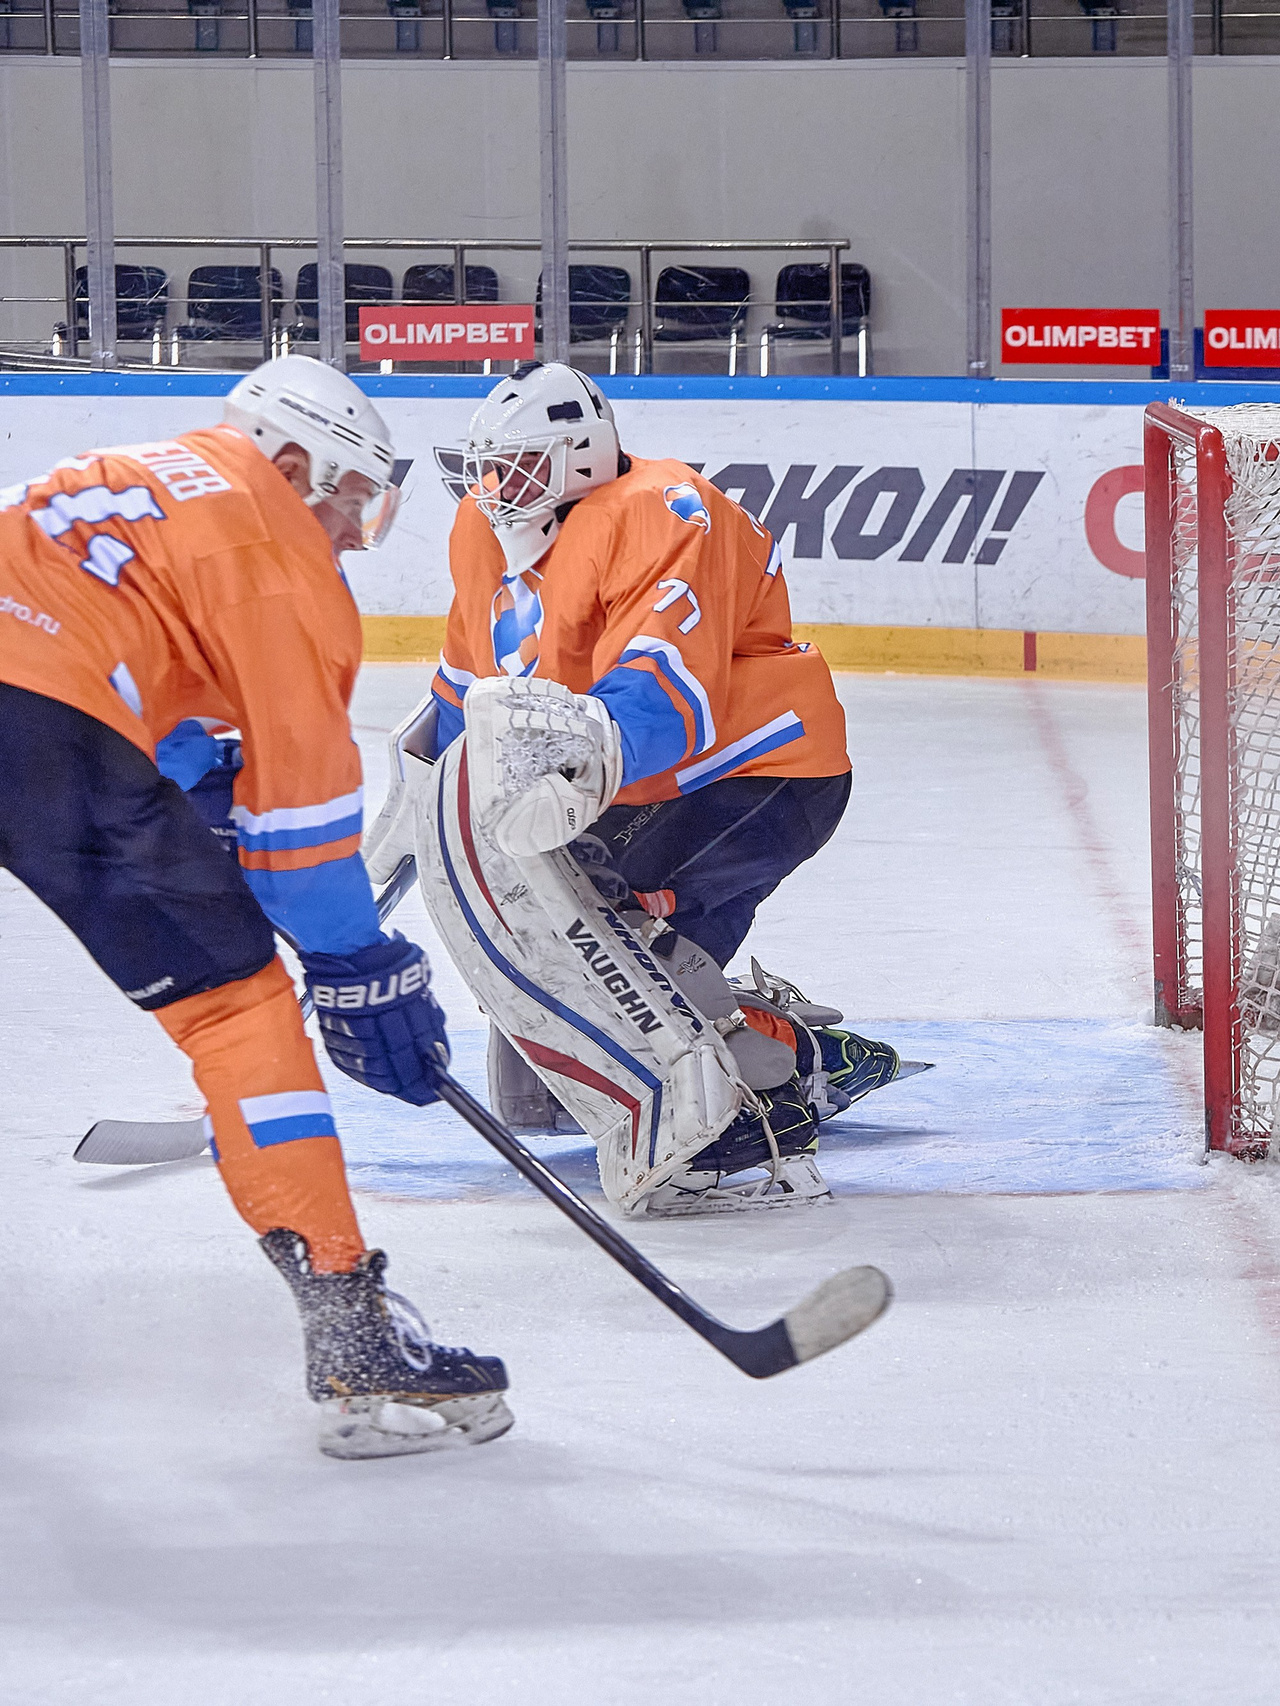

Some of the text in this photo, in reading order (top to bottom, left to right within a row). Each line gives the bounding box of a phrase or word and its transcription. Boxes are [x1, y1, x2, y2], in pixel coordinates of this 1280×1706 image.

[364, 322, 529, 344] OLIMPBET
[1005, 325, 1156, 348] OLIMPBET
[565, 917, 664, 1035] VAUGHN
